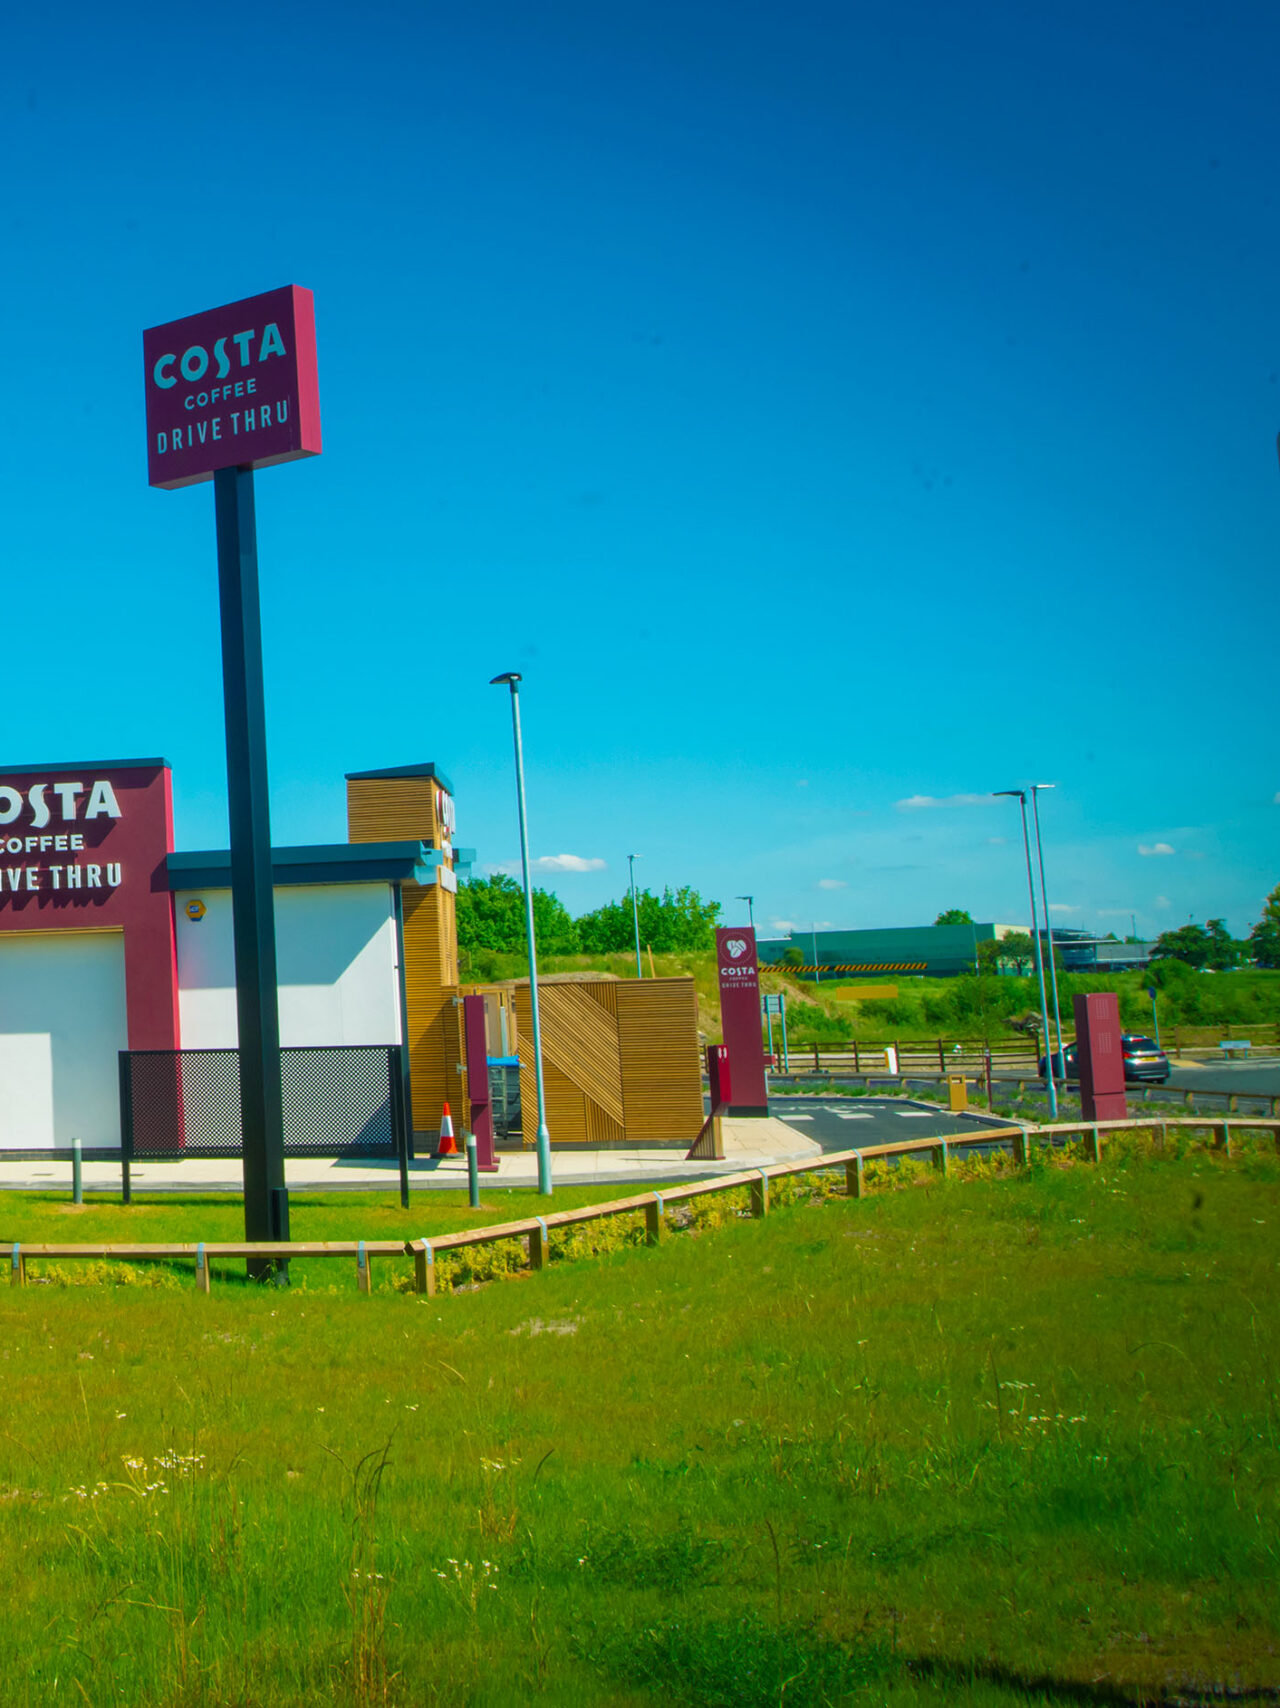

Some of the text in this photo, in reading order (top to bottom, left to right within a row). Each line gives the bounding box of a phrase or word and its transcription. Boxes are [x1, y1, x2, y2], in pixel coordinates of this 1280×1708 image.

[153, 323, 286, 389] COSTA
[184, 378, 256, 410] COFFEE
[157, 399, 287, 454] DRIVE THRU
[49, 863, 122, 890] THRU
[721, 967, 755, 976] COSTA
